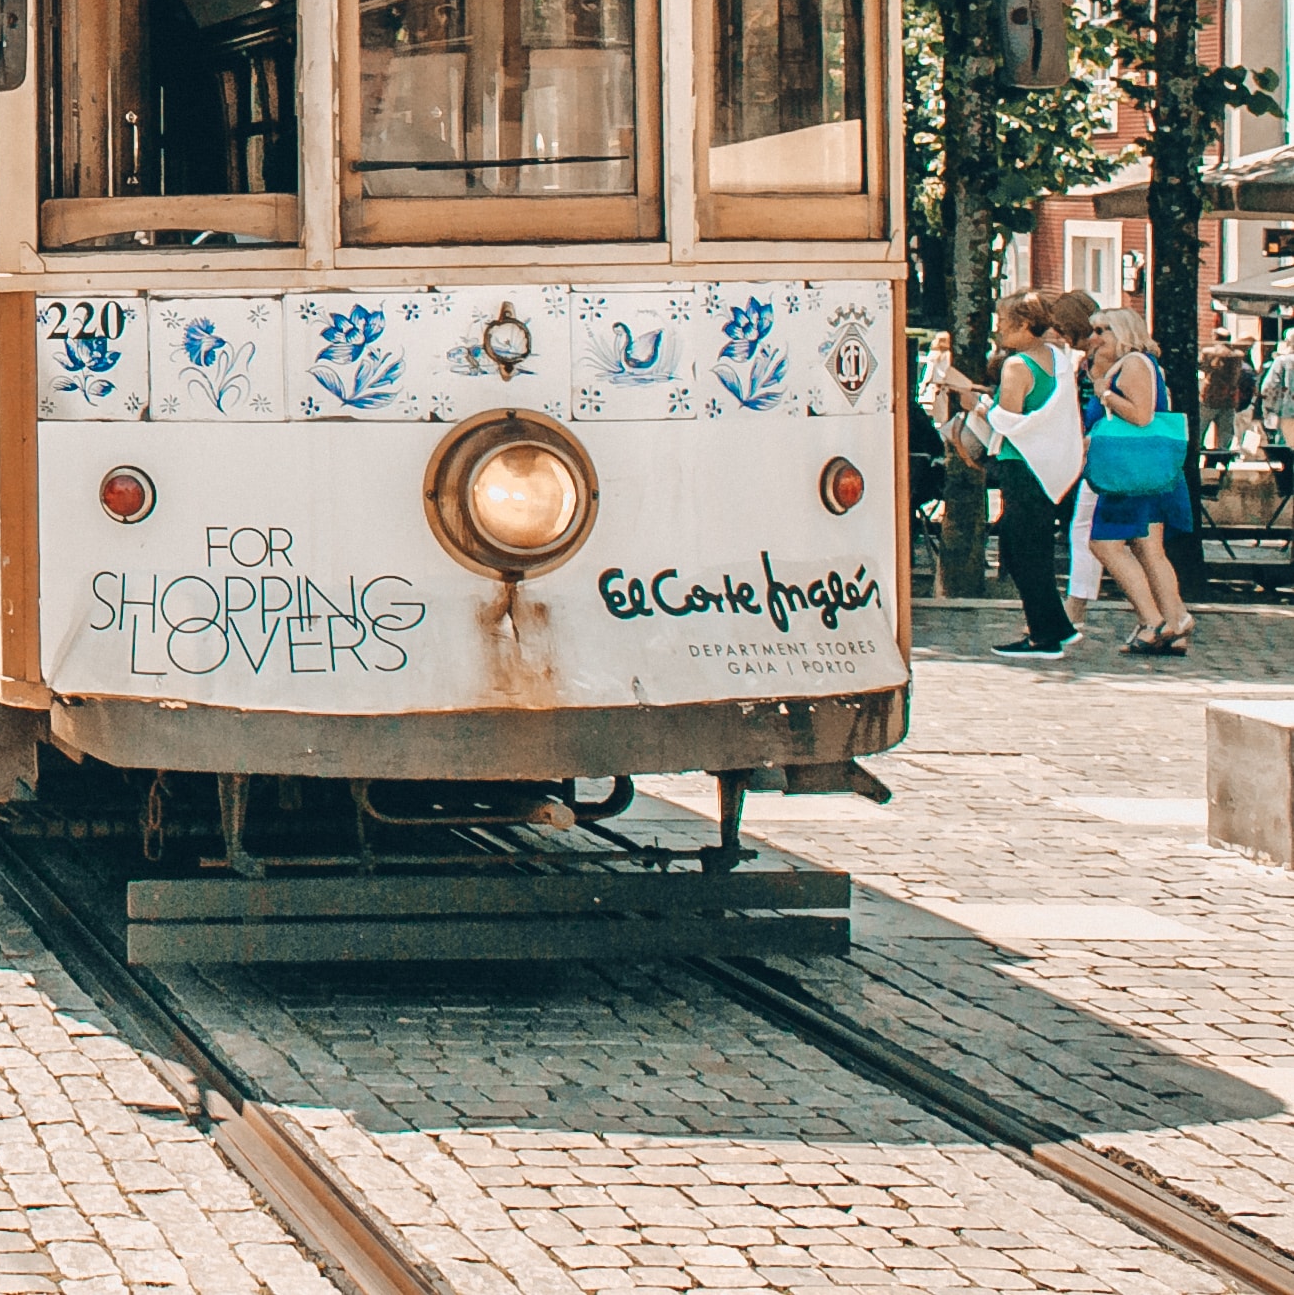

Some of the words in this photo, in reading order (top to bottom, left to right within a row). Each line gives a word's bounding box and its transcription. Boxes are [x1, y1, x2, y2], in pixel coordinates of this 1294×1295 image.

[46, 301, 125, 340] 220
[205, 526, 293, 568] FOR
[90, 571, 426, 634] SHOPPING
[597, 567, 654, 619] El
[650, 568, 762, 617] Corte
[760, 550, 882, 633] Inglés
[130, 613, 408, 675] LOVERS
[688, 642, 809, 657] DEPARTMENT
[816, 640, 876, 656] STORES
[727, 661, 778, 675] GAIA
[802, 660, 857, 674] PORTO
